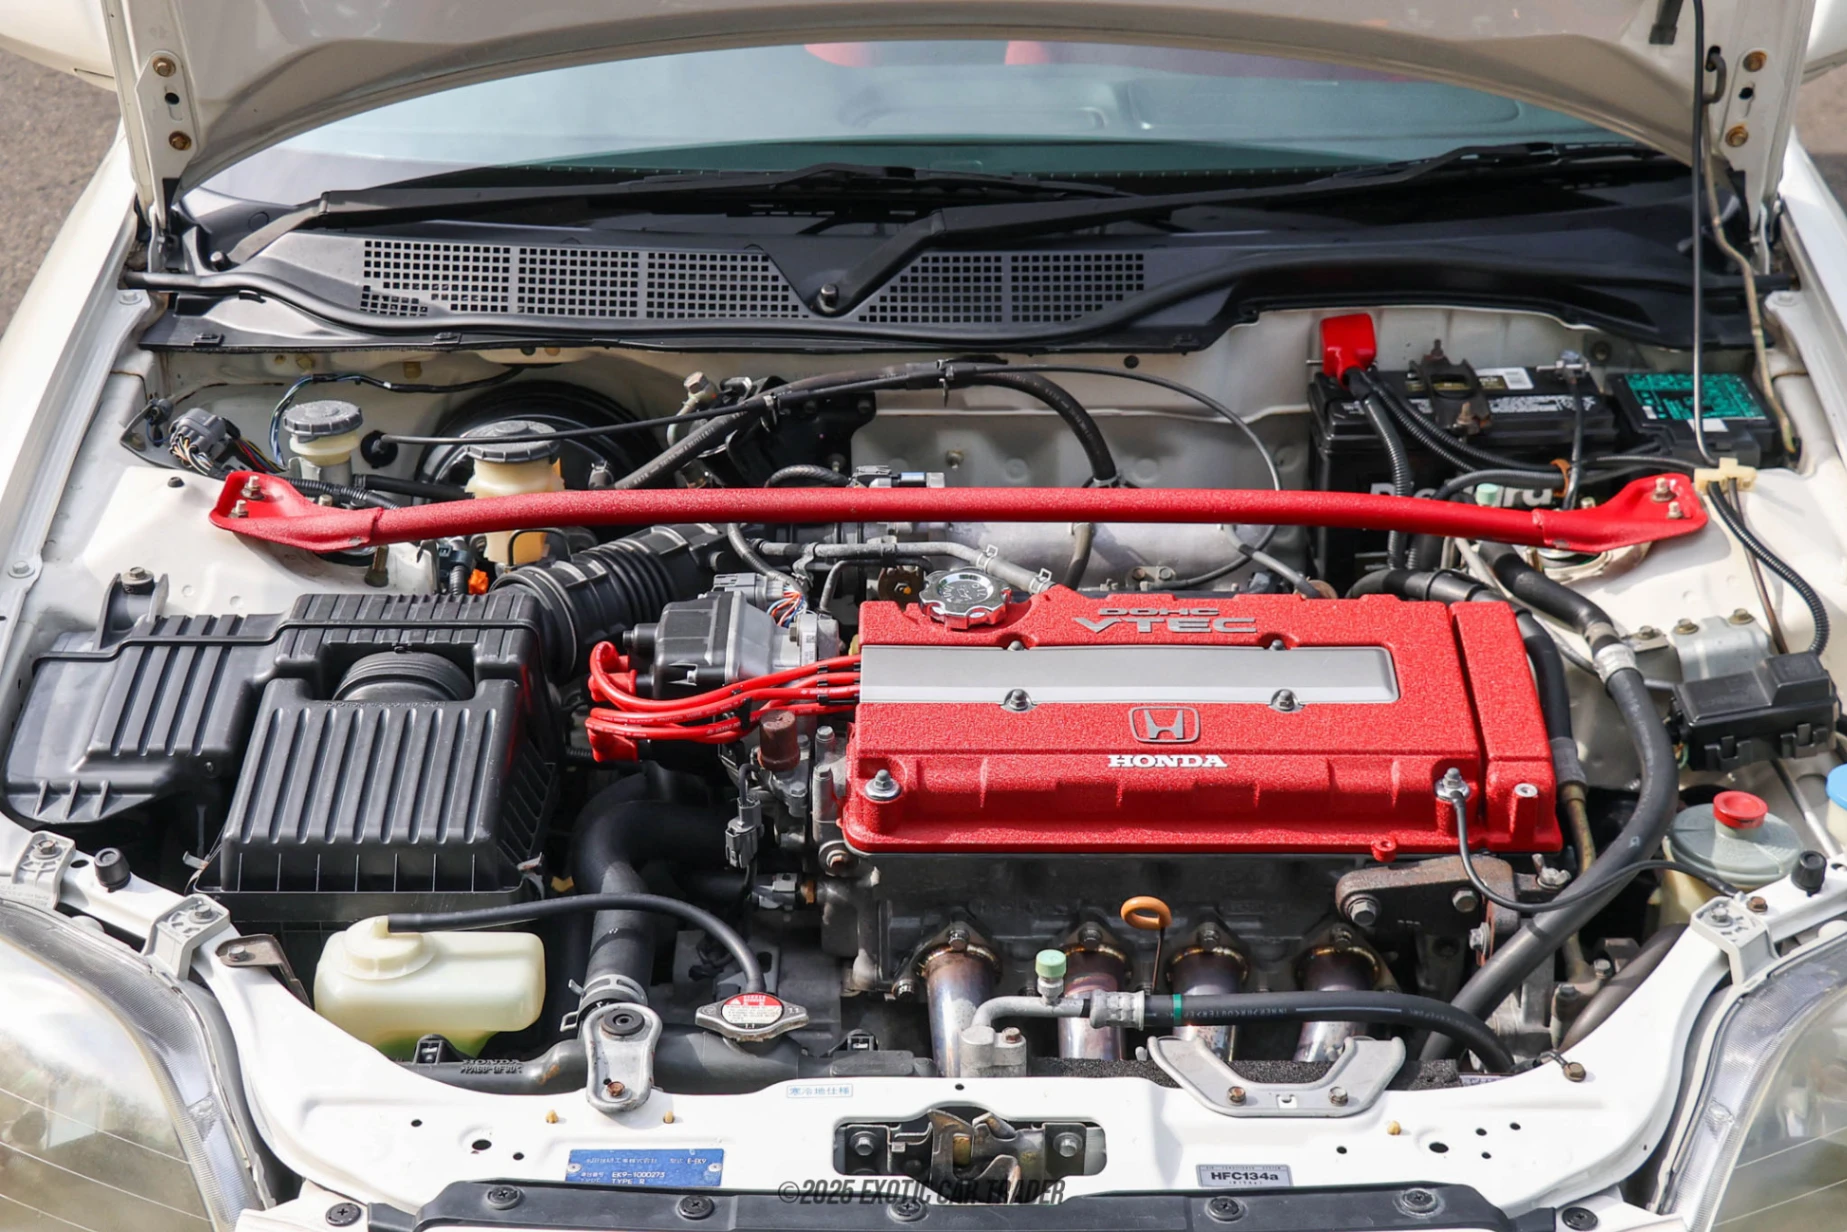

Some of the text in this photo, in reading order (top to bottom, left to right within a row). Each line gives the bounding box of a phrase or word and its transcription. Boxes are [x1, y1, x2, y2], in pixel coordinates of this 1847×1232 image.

[1098, 607, 1220, 617] DOHC
[1072, 617, 1258, 633] VTEC
[1107, 754, 1228, 768] HONDA
[1210, 1171, 1279, 1181] HFC134a
